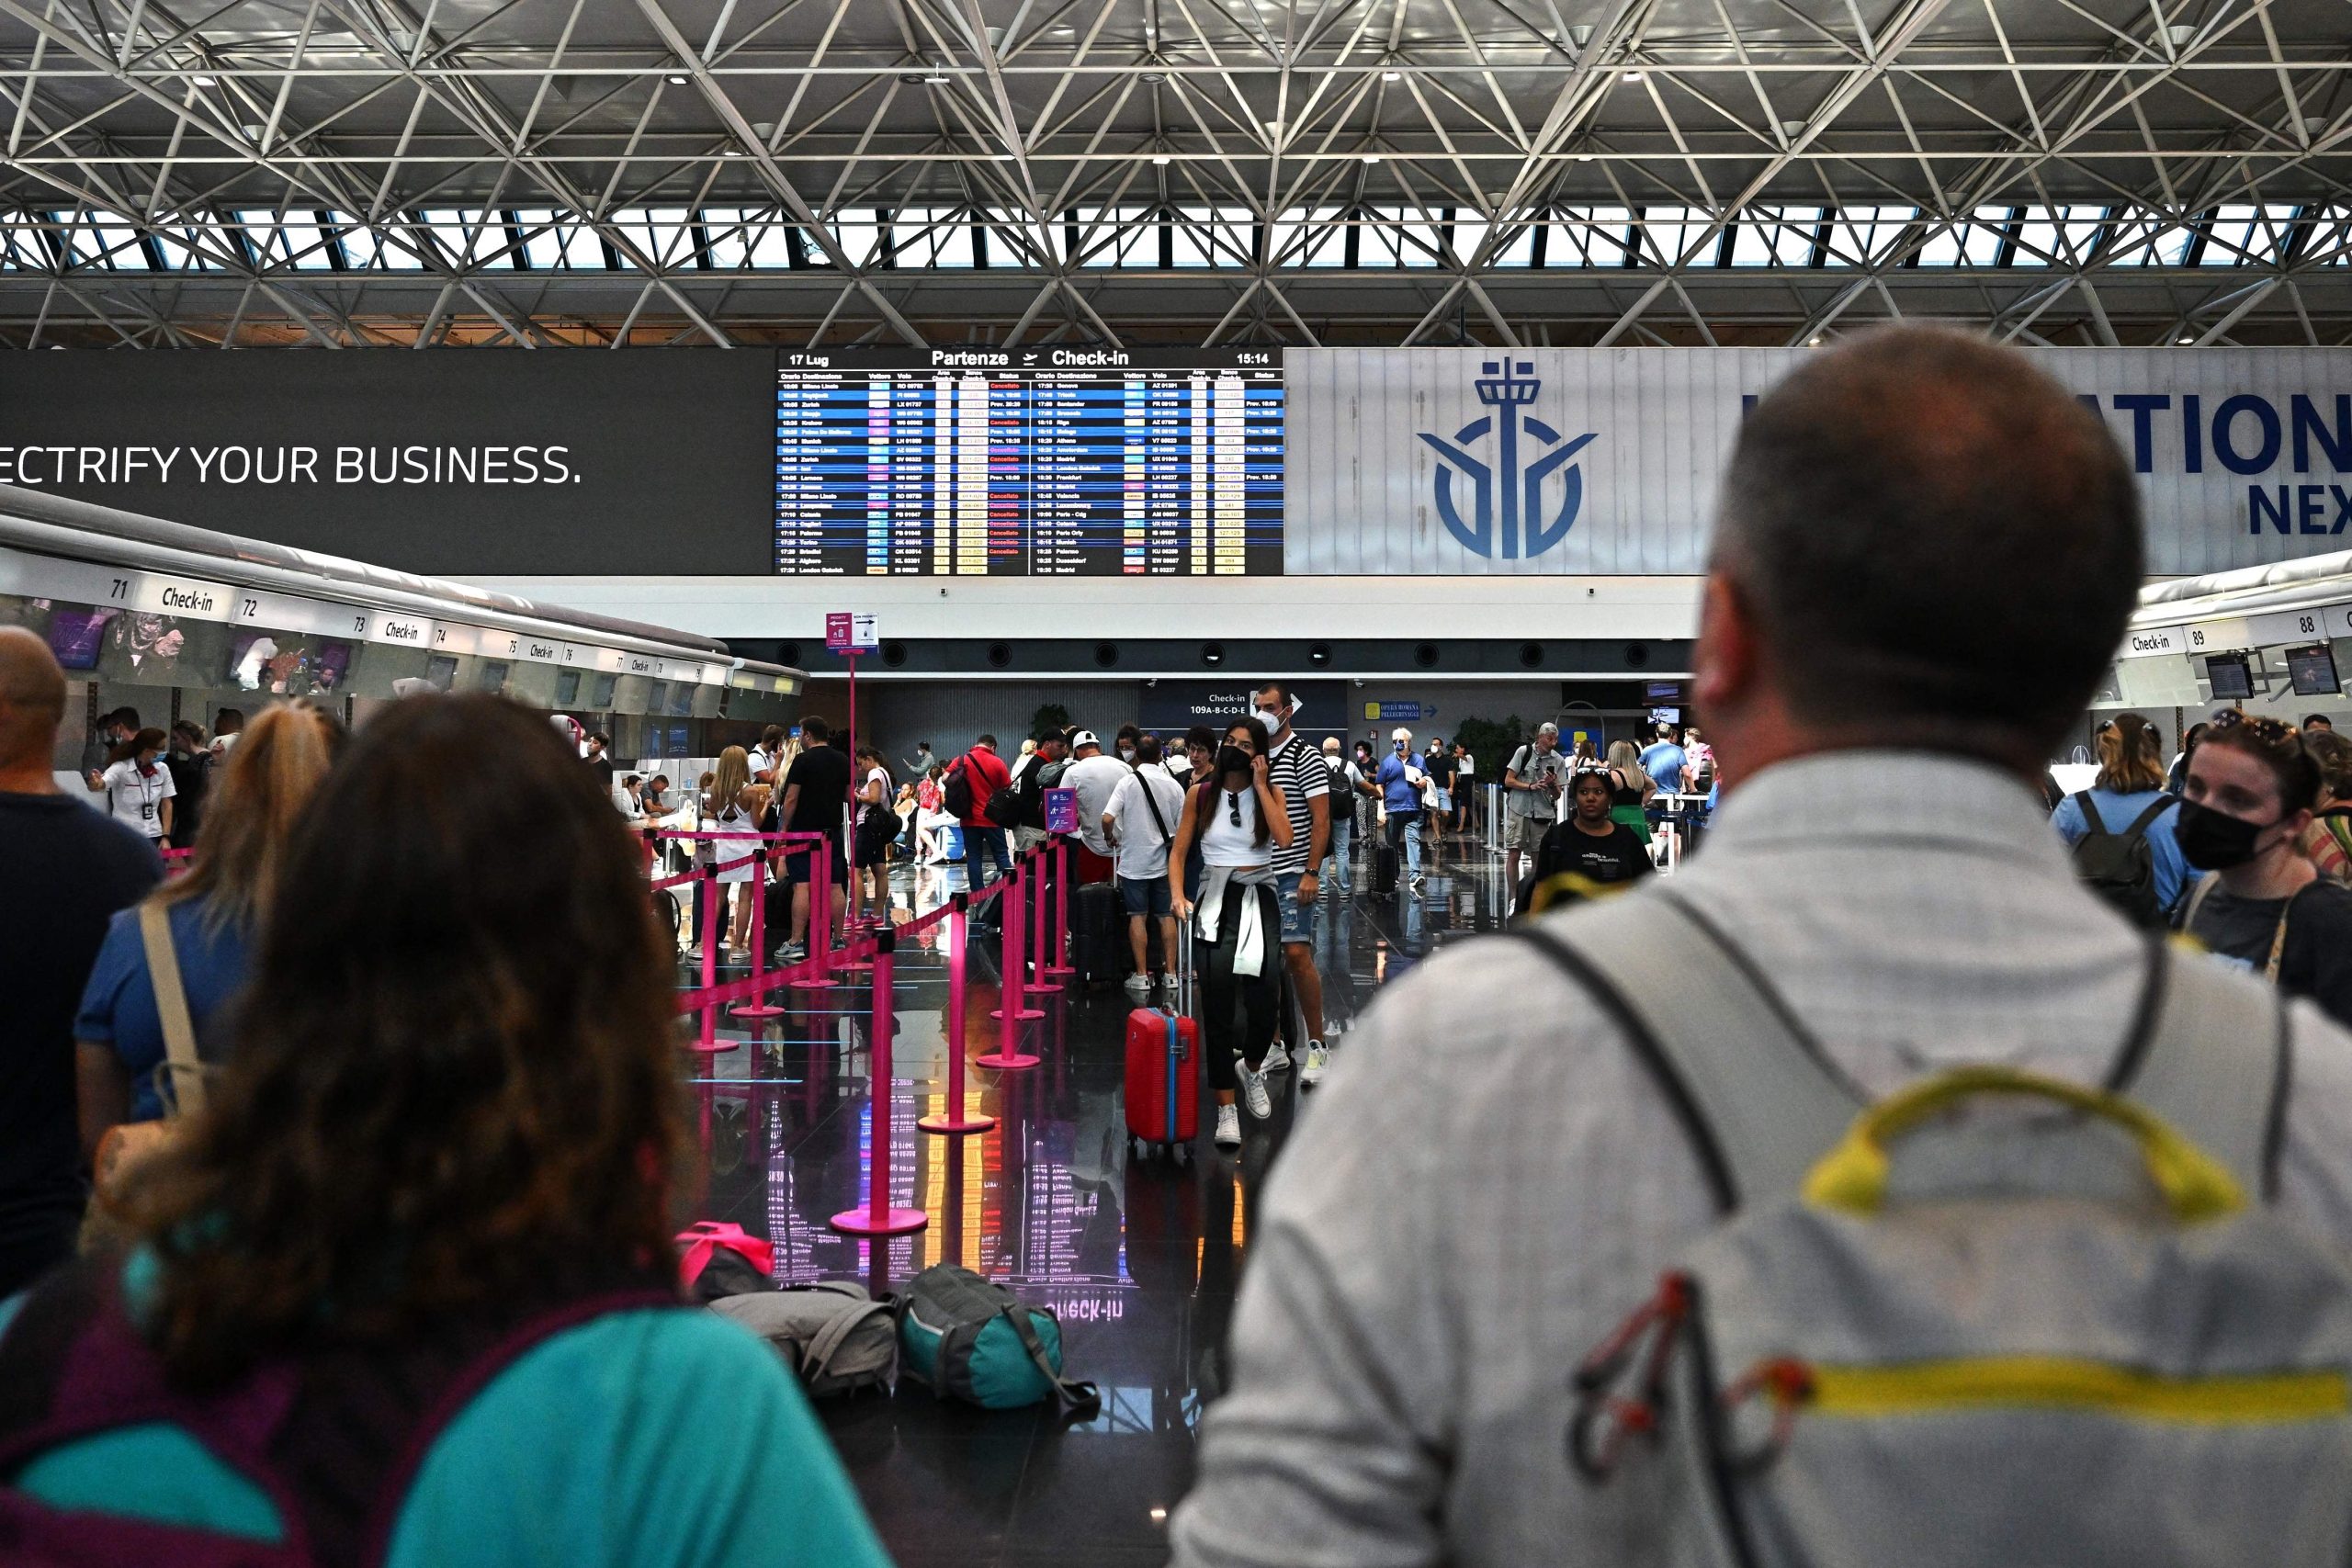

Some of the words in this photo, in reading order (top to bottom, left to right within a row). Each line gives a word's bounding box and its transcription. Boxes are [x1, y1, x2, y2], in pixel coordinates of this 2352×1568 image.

[790, 355, 803, 365] 17
[807, 355, 829, 367] Lug
[933, 351, 1009, 366] Partenze
[1052, 350, 1129, 366] Check-in
[1238, 354, 1269, 364] 15:14
[189, 446, 319, 483] YOUR
[335, 446, 582, 483] BUSINESS.
[111, 580, 128, 599] 71
[162, 587, 213, 612] Check-in
[243, 599, 257, 616] 72
[354, 616, 366, 632] 73
[386, 622, 418, 640] Check-in
[435, 629, 446, 644] 74
[2300, 616, 2314, 633] 88
[2132, 635, 2170, 652] Check-in
[2192, 630, 2205, 646] 89
[508, 640, 516, 653] 75
[530, 644, 553, 659] Check-in
[565, 649, 573, 660] 76
[616, 657, 623, 668] 77
[632, 660, 649, 671] Check-in
[1209, 694, 1245, 703] Check-in
[1191, 705, 1245, 714] 109A-B-C-D-E
